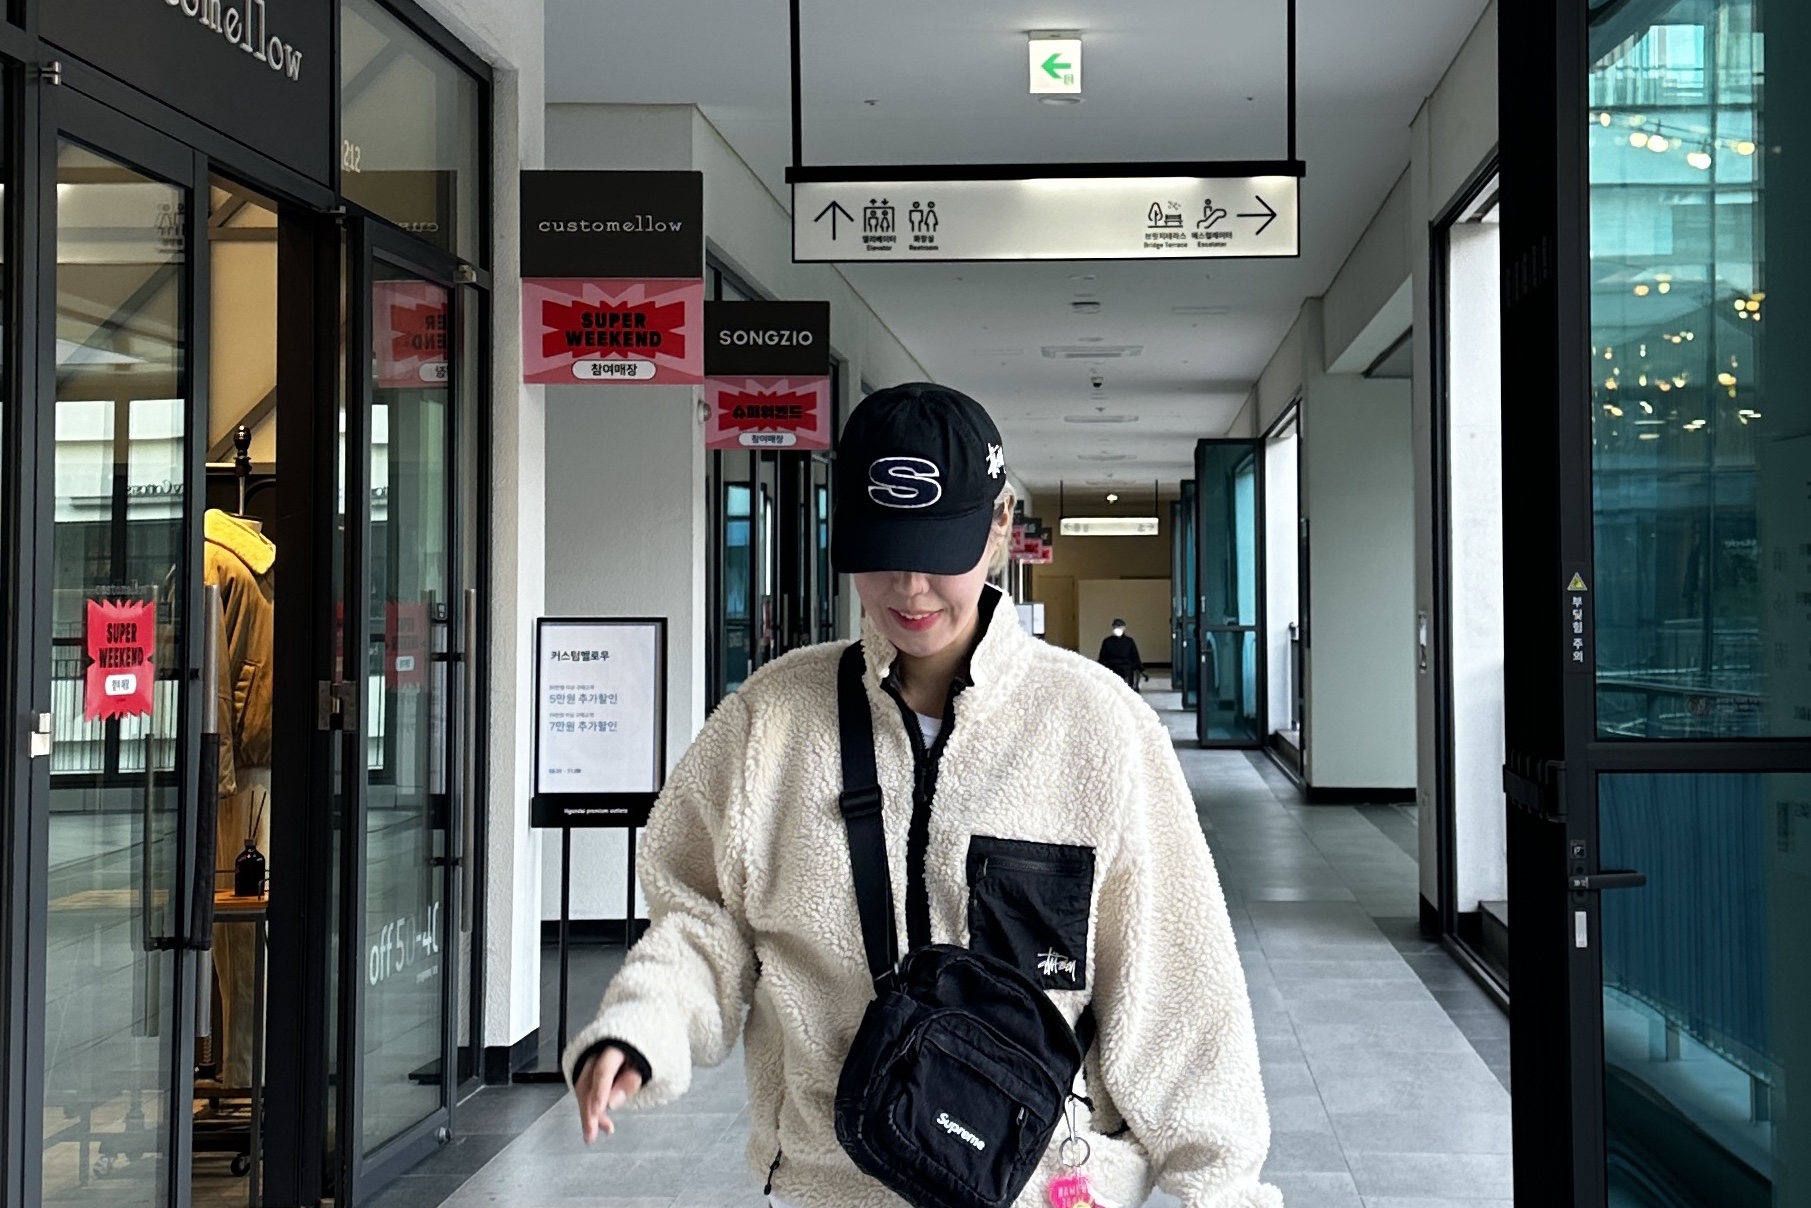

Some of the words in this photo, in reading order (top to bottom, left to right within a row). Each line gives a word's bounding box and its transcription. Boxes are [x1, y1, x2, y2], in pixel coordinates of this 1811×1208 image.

[165, 0, 302, 81] mellow
[538, 215, 683, 232] customellow
[581, 311, 647, 329] SUPER
[565, 331, 662, 348] WEEKEND
[719, 330, 813, 346] SONGZIO
[591, 363, 638, 377] 참여매장
[868, 456, 942, 509] S
[107, 622, 137, 644] SUPER
[99, 646, 144, 668] WEEKEND
[1572, 637, 1584, 663] 주의
[549, 693, 576, 705] 5만원
[578, 693, 618, 705] 추가할인
[549, 721, 575, 732] 7만원
[578, 721, 618, 732] 추가할인
[369, 922, 394, 986] off
[936, 1112, 986, 1151] Supreme
